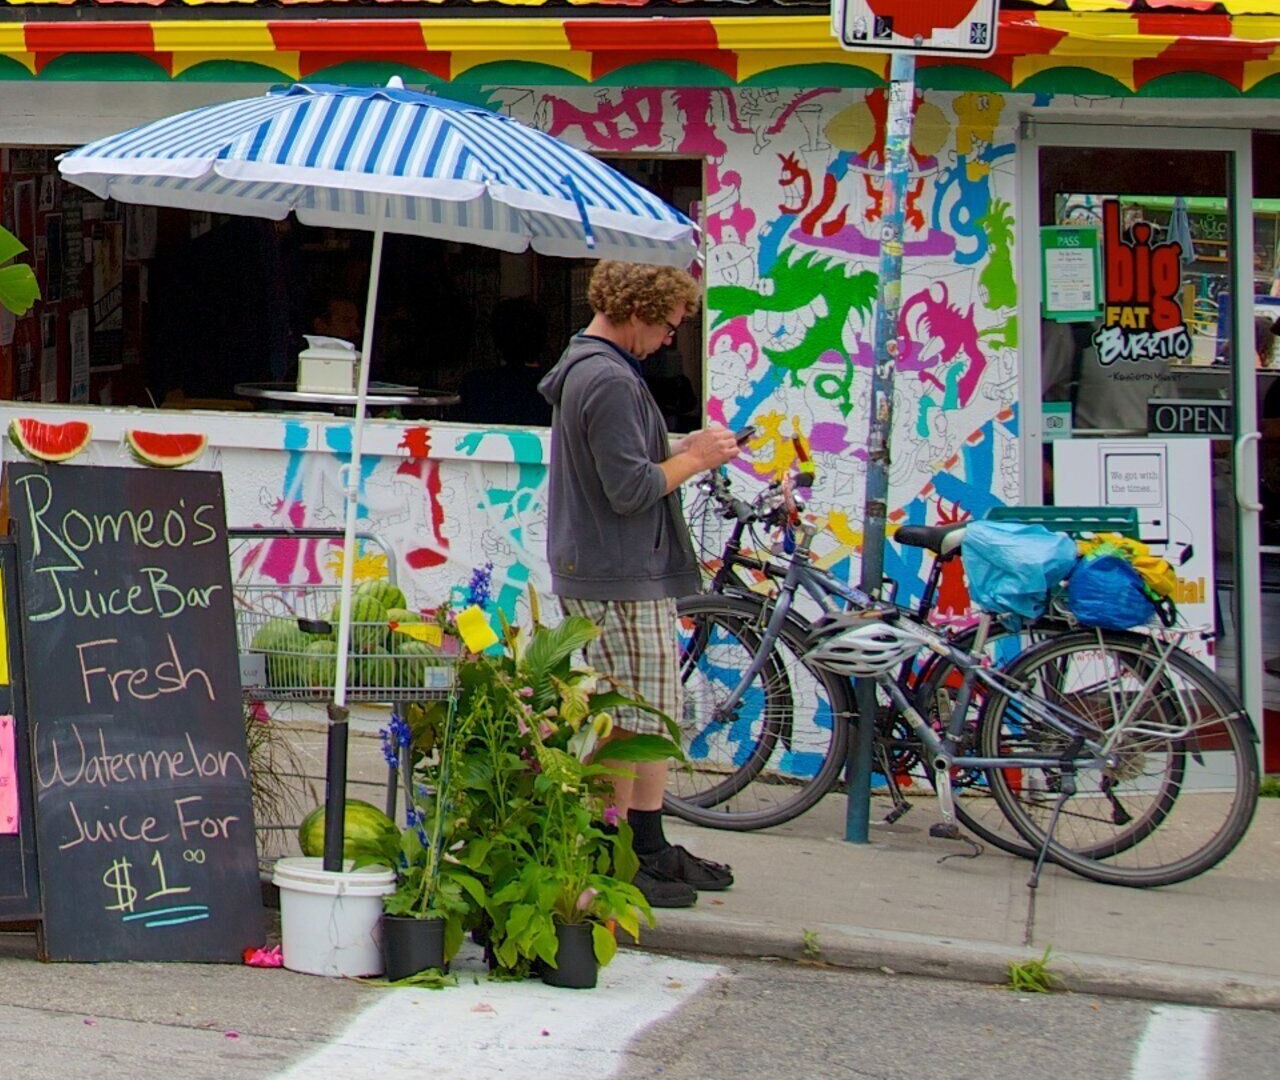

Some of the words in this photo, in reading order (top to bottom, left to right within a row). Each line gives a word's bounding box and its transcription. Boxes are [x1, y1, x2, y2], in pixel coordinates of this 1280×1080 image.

[1057, 237, 1080, 247] PASS
[1103, 199, 1181, 331] big
[1107, 306, 1150, 328] FAT
[1096, 326, 1189, 365] BURRITO
[1155, 406, 1227, 434] OPEN
[1111, 471, 1123, 480] We
[1124, 471, 1139, 482] got
[1140, 470, 1159, 480] with
[1111, 484, 1125, 493] the
[15, 475, 217, 570] Romeo's
[75, 633, 217, 704] Fresh
[35, 722, 247, 789] Watermelon
[58, 801, 170, 851] Juice
[174, 796, 239, 842] For
